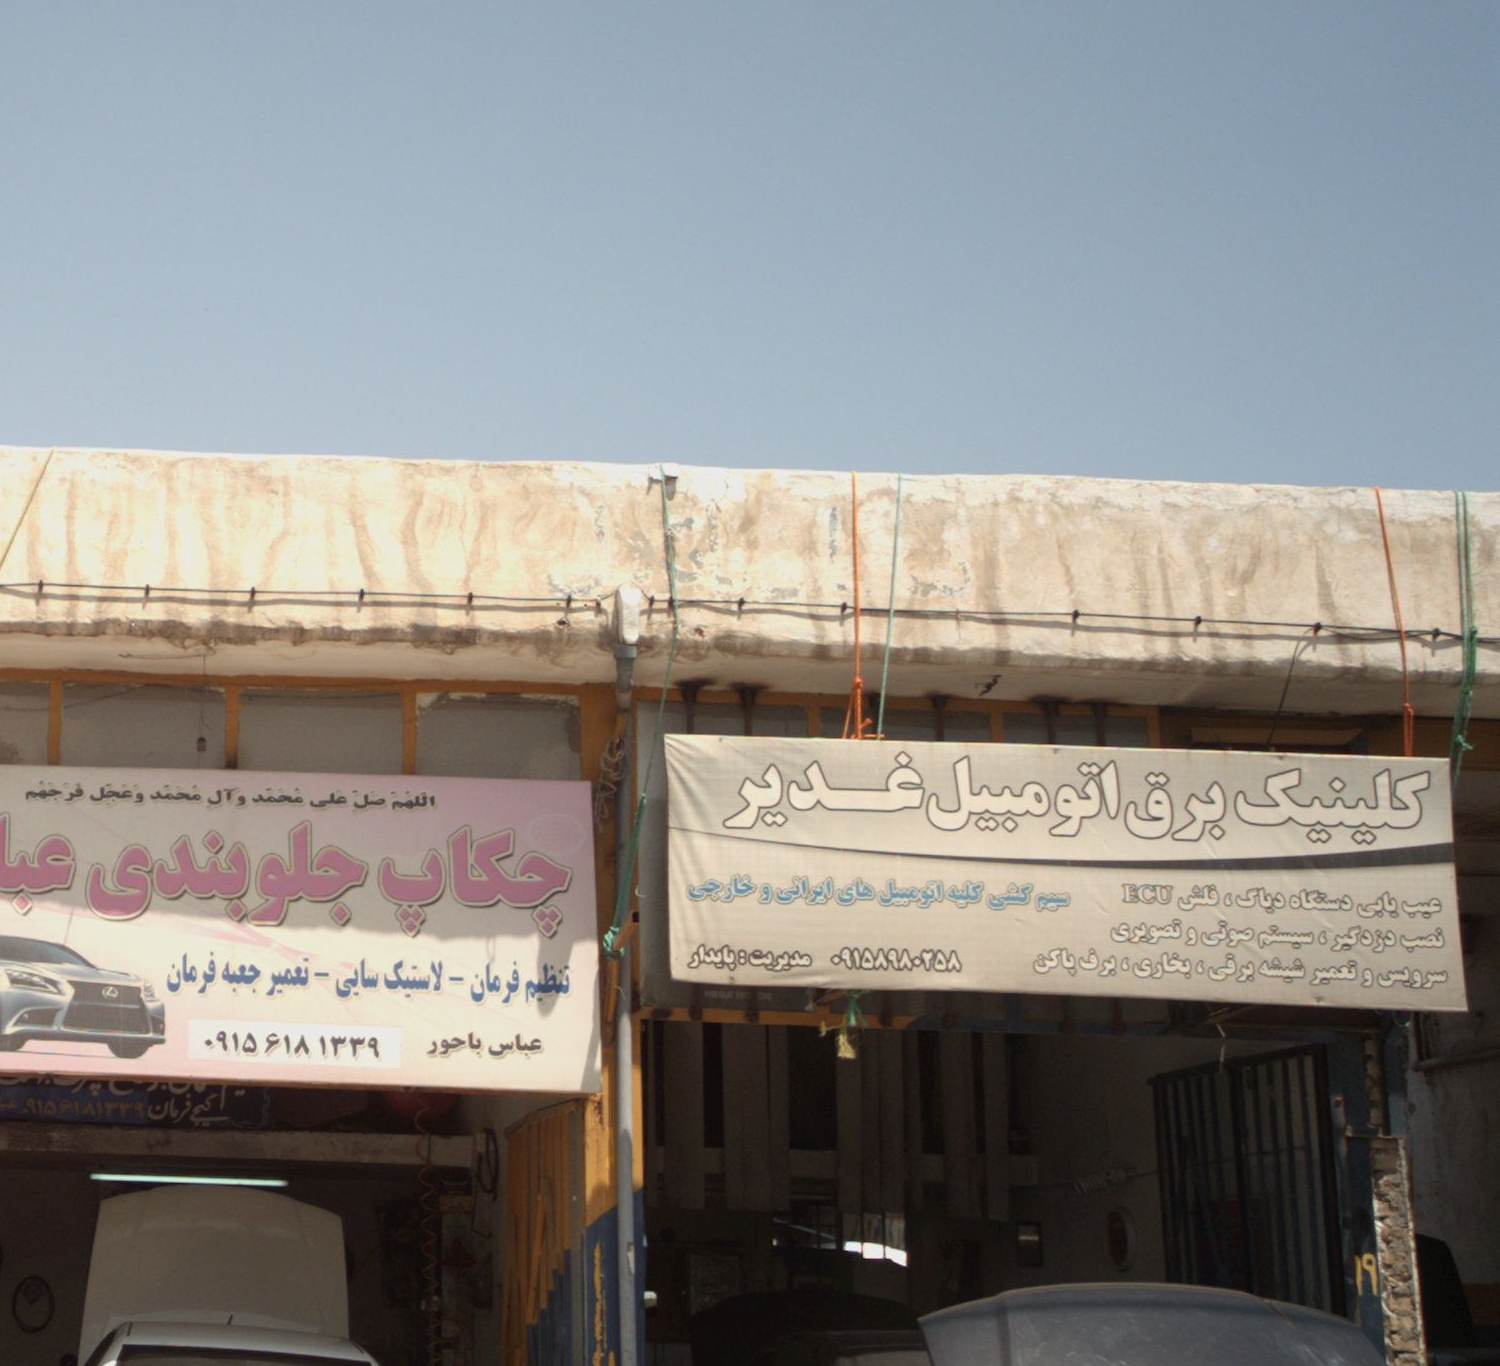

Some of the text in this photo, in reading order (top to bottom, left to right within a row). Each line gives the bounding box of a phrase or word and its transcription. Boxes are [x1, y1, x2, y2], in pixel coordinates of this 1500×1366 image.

[723, 751, 1430, 845] کلینیک برق اتومبیل غدیر
[378, 823, 573, 937] چکاپ
[687, 873, 1071, 912] سیم کشی کلیه اتومبیل های ایرانی و خارجی
[1121, 883, 1174, 905] ECU
[1177, 883, 1220, 911] فلش
[1288, 888, 1353, 912] دستگاه
[1356, 891, 1398, 919] یابی
[1402, 897, 1442, 919] عیب
[1110, 918, 1182, 945] تصویری
[1185, 926, 1198, 947] و
[1201, 920, 1255, 948] صوتی
[1257, 924, 1314, 950] سیستم
[1400, 927, 1445, 953] نصب
[687, 943, 737, 971] پایدار
[750, 948, 813, 972] مدیریت
[830, 946, 962, 973] ۰۹۱۵۸۹۸۰۲۵۸
[1132, 951, 1192, 980] بخاری
[1208, 953, 1255, 983] برقی
[1259, 956, 1306, 983] شیشه
[166, 951, 217, 994] فرمان
[221, 960, 262, 995] جعبه
[266, 956, 310, 996] تعمیر
[383, 959, 444, 999] لاستیک
[470, 960, 521, 1004] فرمان
[525, 962, 571, 1004] تنظیم
[1309, 959, 1357, 986] تعمیر
[1361, 966, 1373, 988] و
[1377, 965, 1448, 989] سرویس
[487, 1033, 543, 1059] عباس
